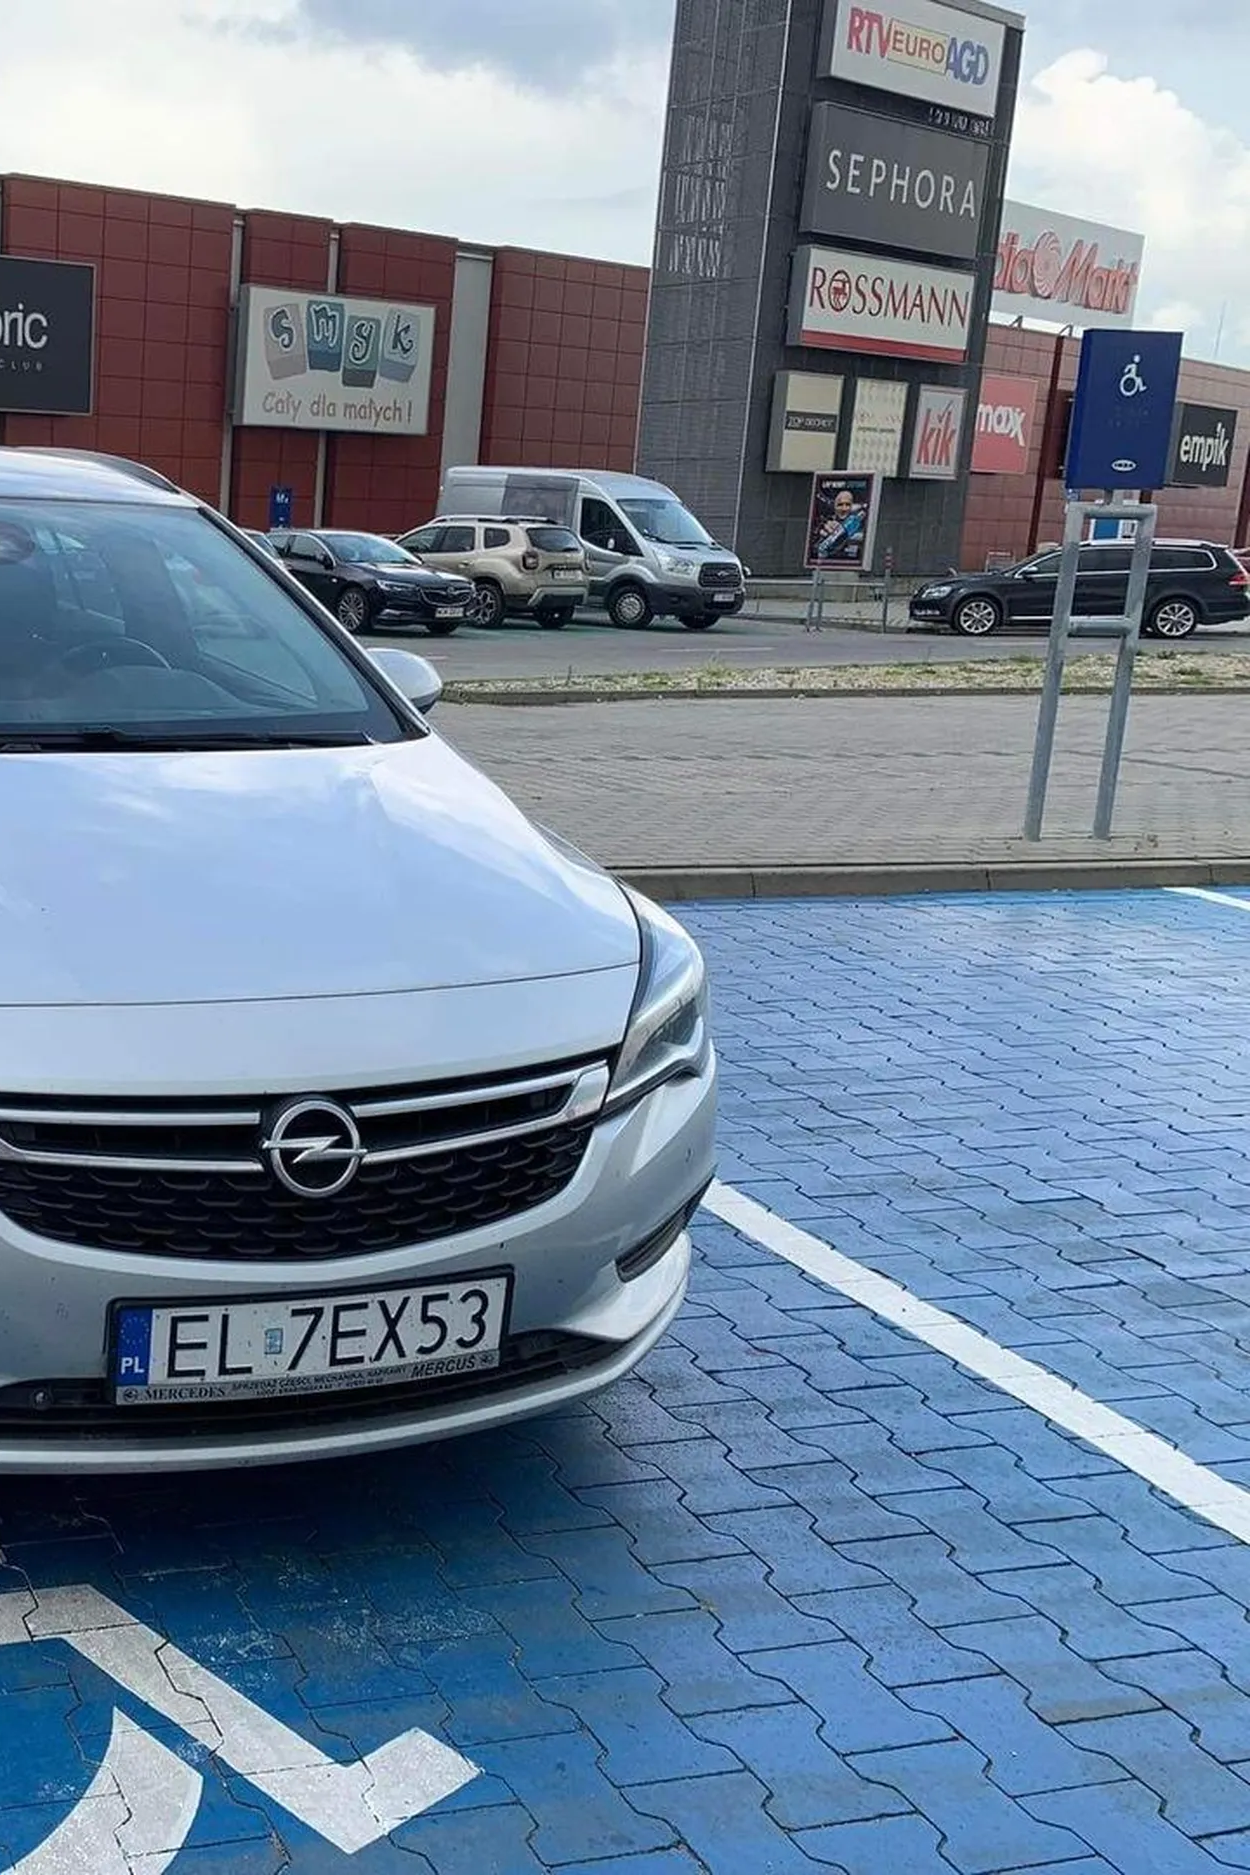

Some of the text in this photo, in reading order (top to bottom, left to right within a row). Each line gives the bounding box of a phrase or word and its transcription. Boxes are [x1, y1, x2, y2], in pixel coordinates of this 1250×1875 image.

[826, 149, 975, 219] SEPHORA
[809, 267, 970, 328] ROSSMANN
[270, 304, 414, 364] smyk
[261, 391, 302, 422] Cały
[310, 393, 336, 418] dla
[916, 402, 956, 466] kik
[1180, 422, 1229, 472] empik
[121, 1288, 490, 1378] PL EL 7EX53
[143, 1386, 227, 1401] MERCEDES
[410, 1355, 476, 1378] MERCUS
